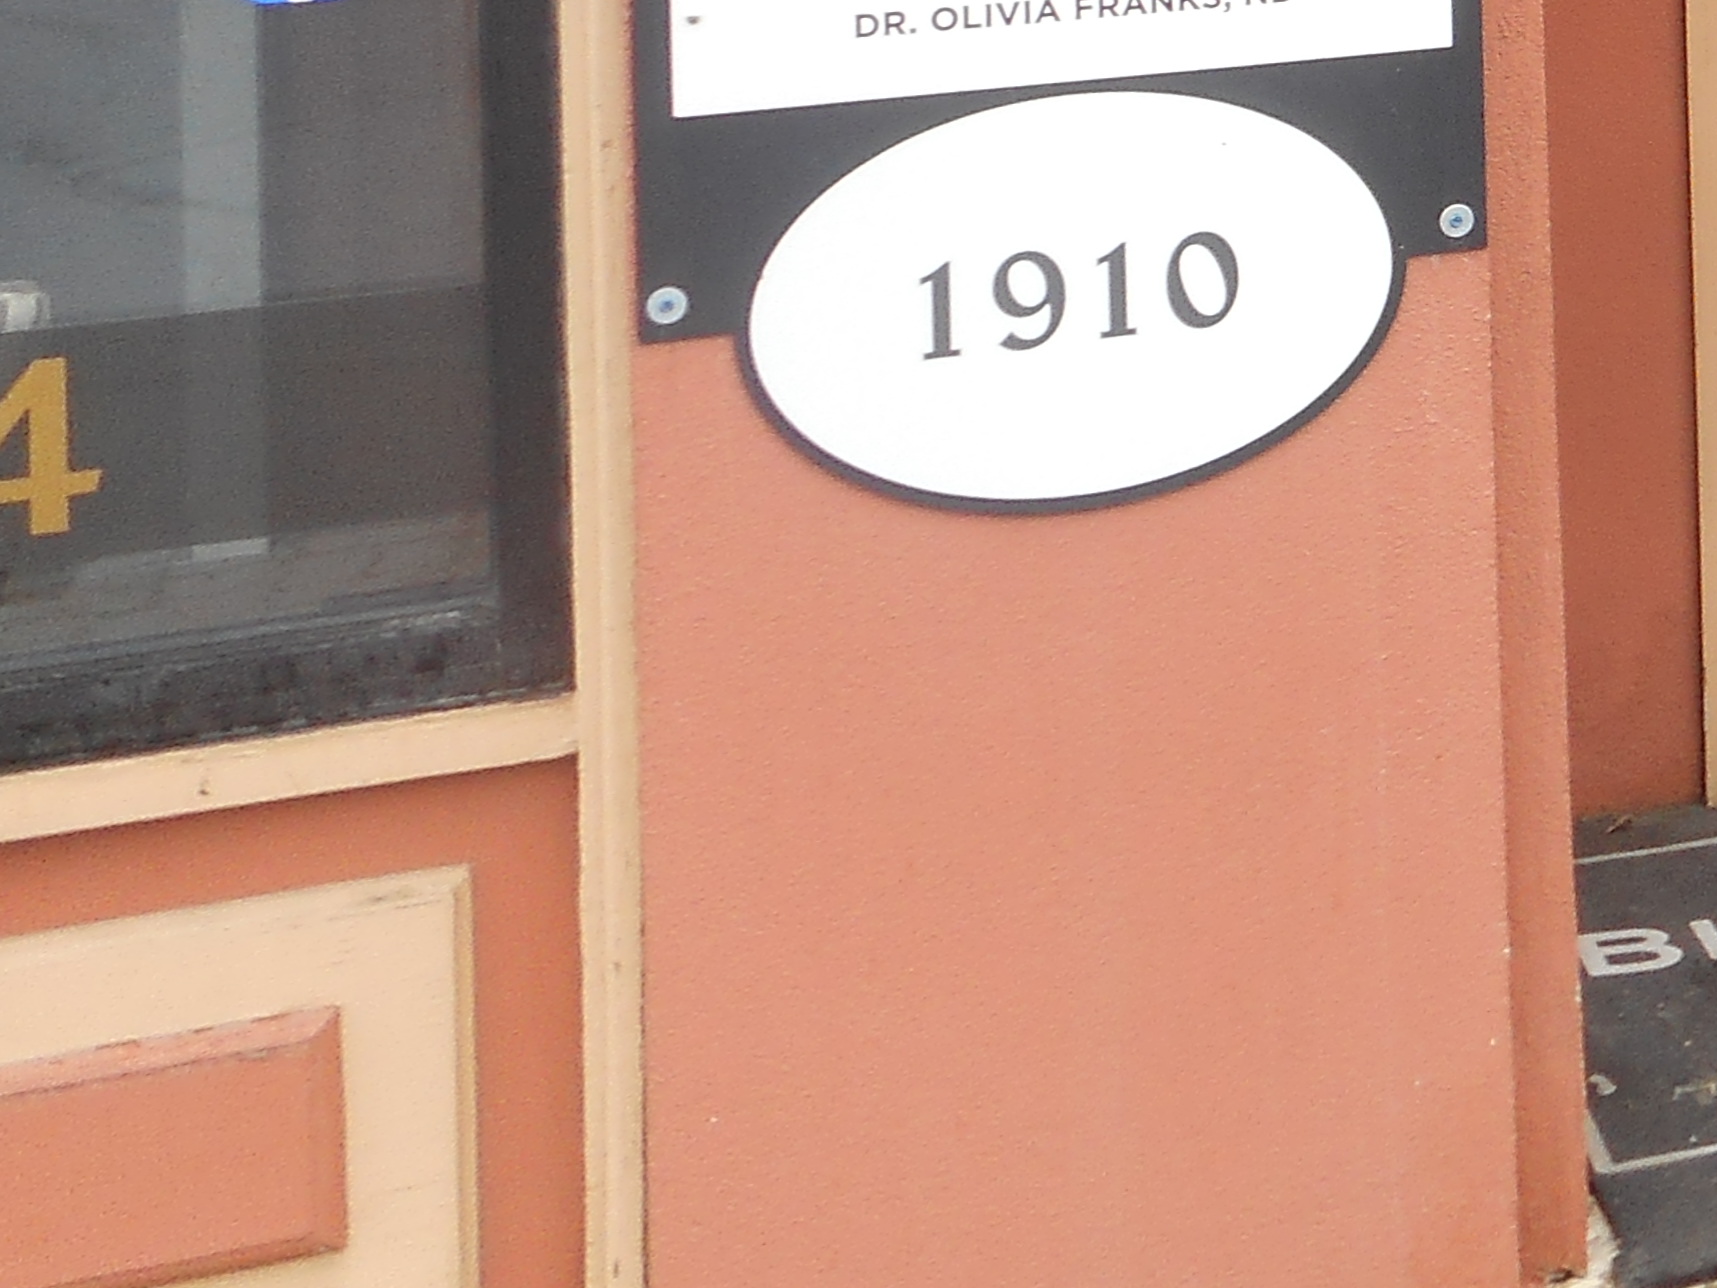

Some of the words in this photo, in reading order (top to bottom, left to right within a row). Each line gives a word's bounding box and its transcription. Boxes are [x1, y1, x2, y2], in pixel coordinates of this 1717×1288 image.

[856, 11, 916, 38] DR.
[931, 0, 1060, 31] OLIVIA
[920, 231, 1239, 360] 1910
